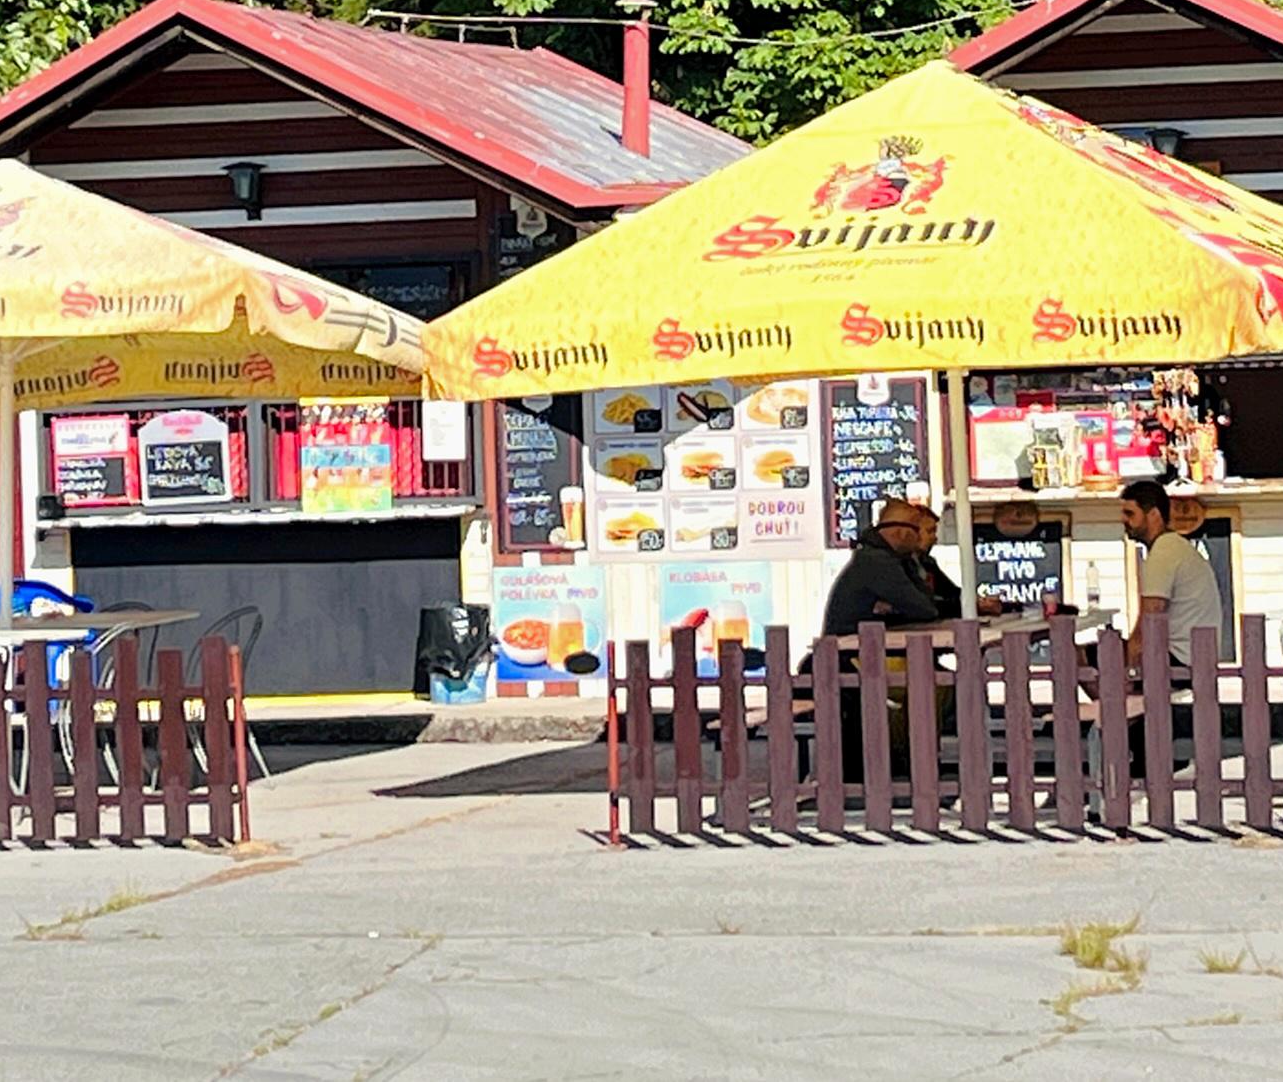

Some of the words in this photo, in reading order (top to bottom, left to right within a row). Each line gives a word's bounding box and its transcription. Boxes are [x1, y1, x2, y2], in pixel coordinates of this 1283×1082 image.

[702, 215, 995, 261] Svijany
[60, 280, 185, 318] Svijany
[1033, 298, 1182, 343] Svijany
[653, 318, 792, 361] Svijany
[840, 303, 984, 346] Svijany
[473, 337, 608, 380] Svijany
[748, 500, 805, 516] DOBROU
